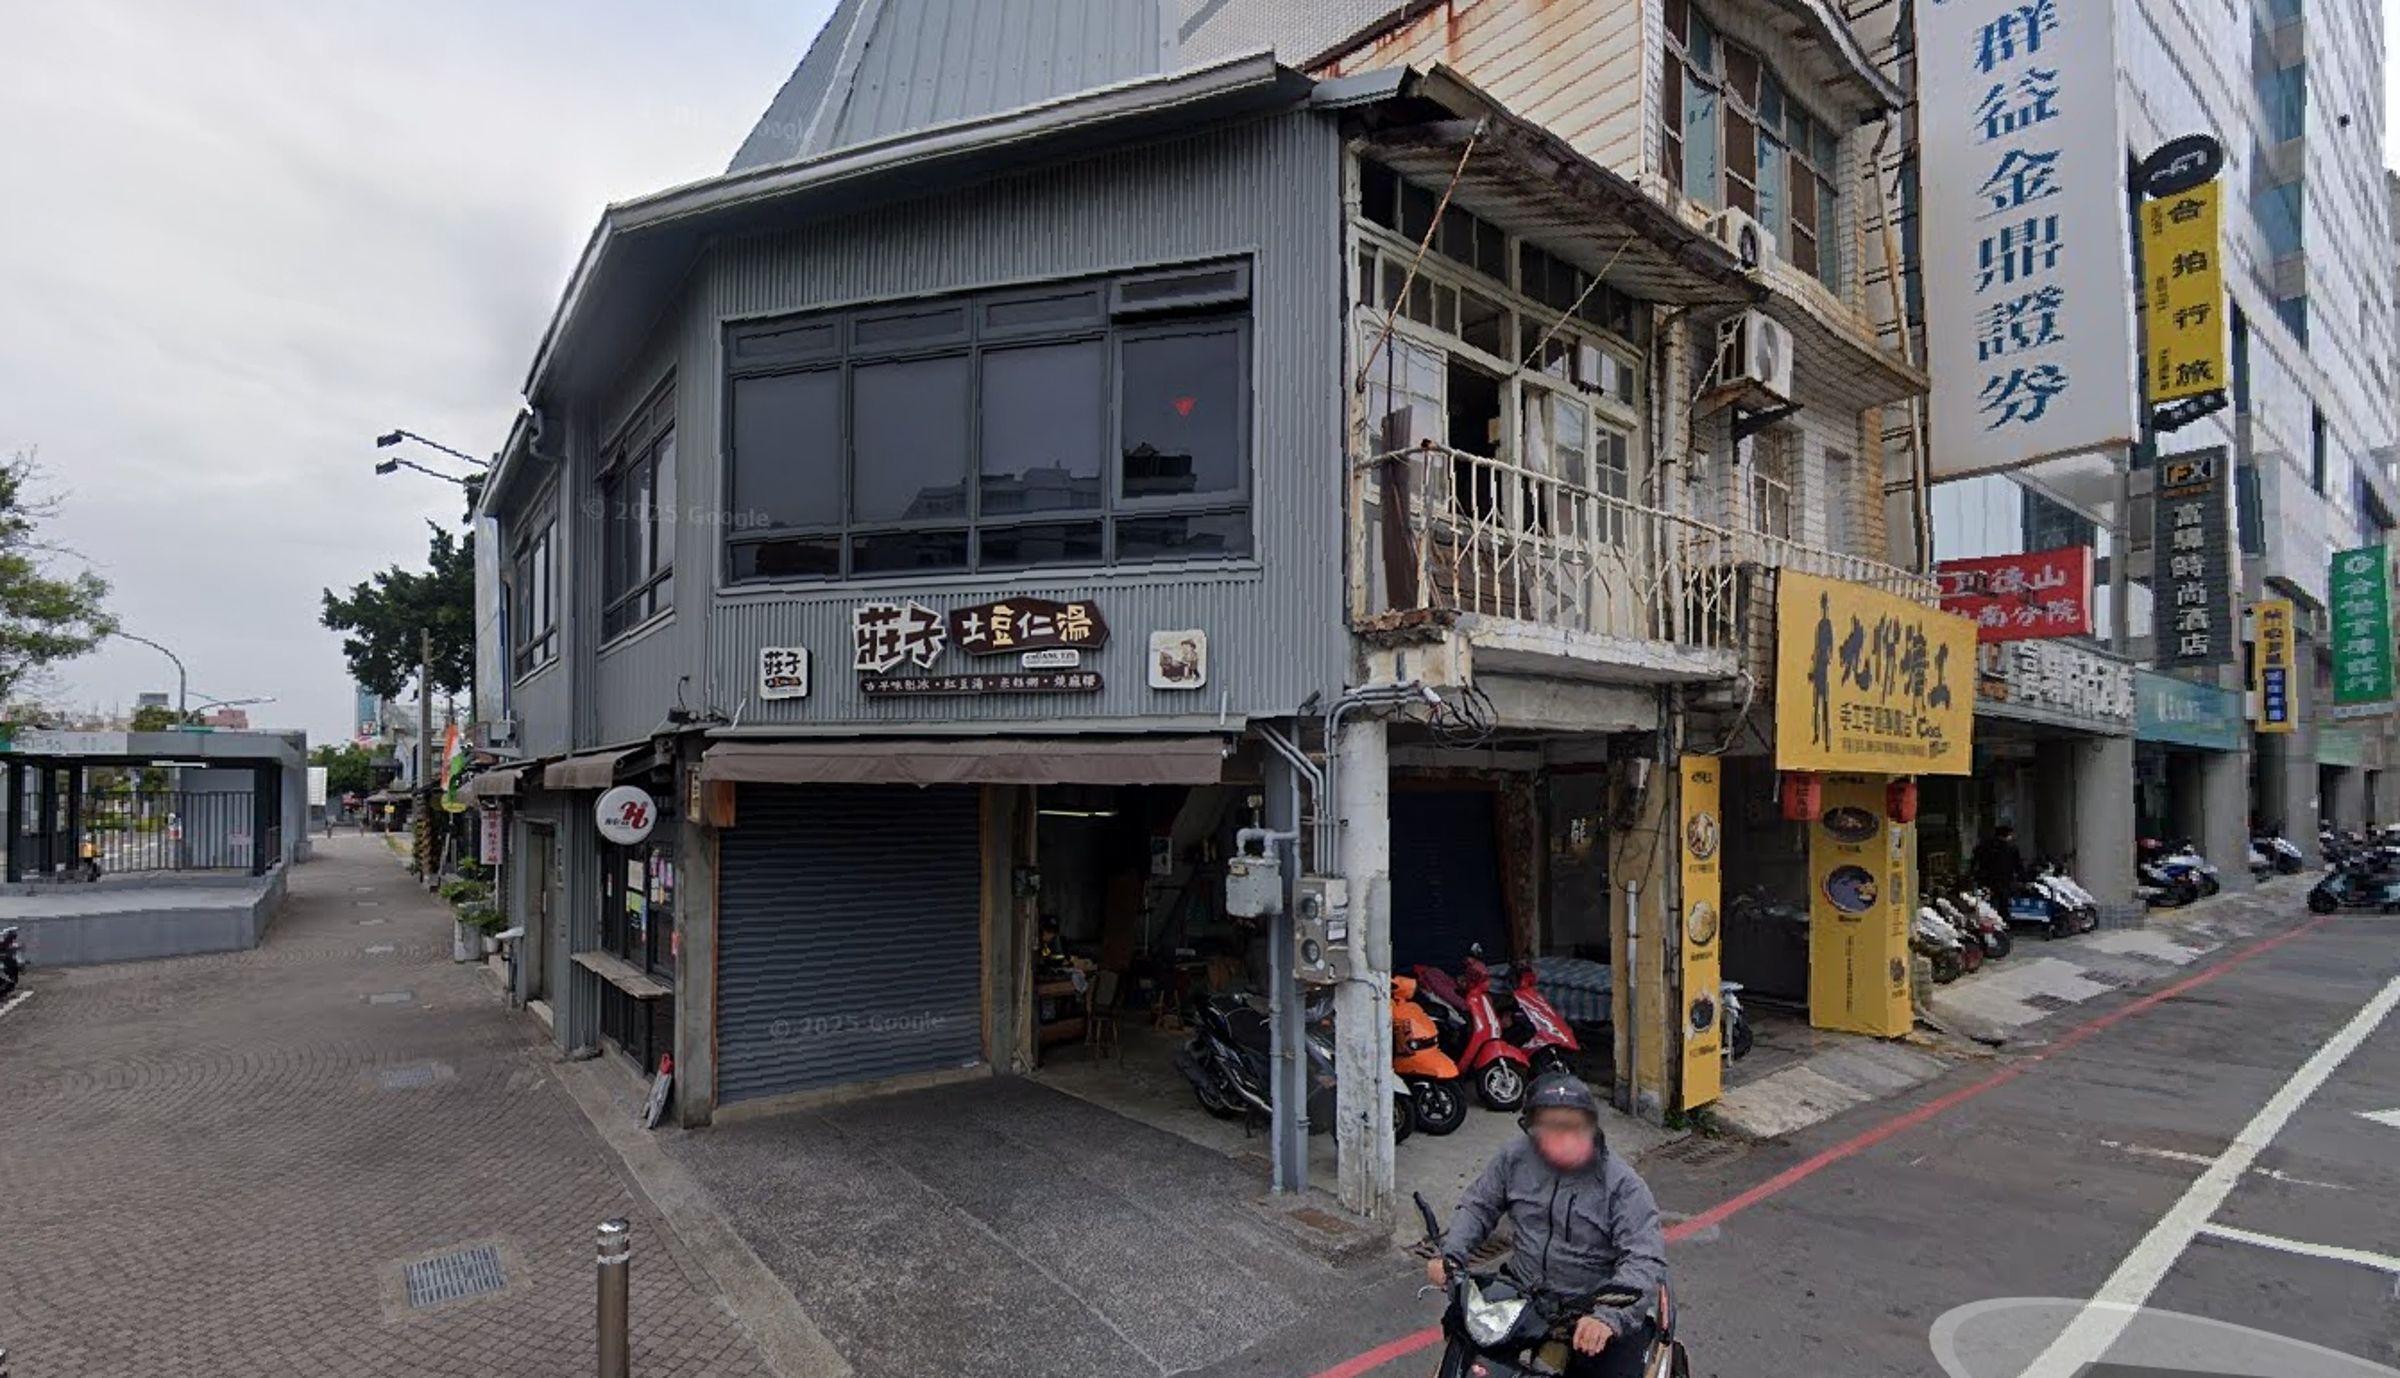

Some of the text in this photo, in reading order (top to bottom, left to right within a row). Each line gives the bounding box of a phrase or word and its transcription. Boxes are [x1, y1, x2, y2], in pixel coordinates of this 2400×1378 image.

[2168, 198, 2215, 387] 合拍行旅
[855, 604, 946, 671] 莊子
[961, 604, 1094, 647] 土豆仁湯
[763, 650, 801, 676] 莊子
